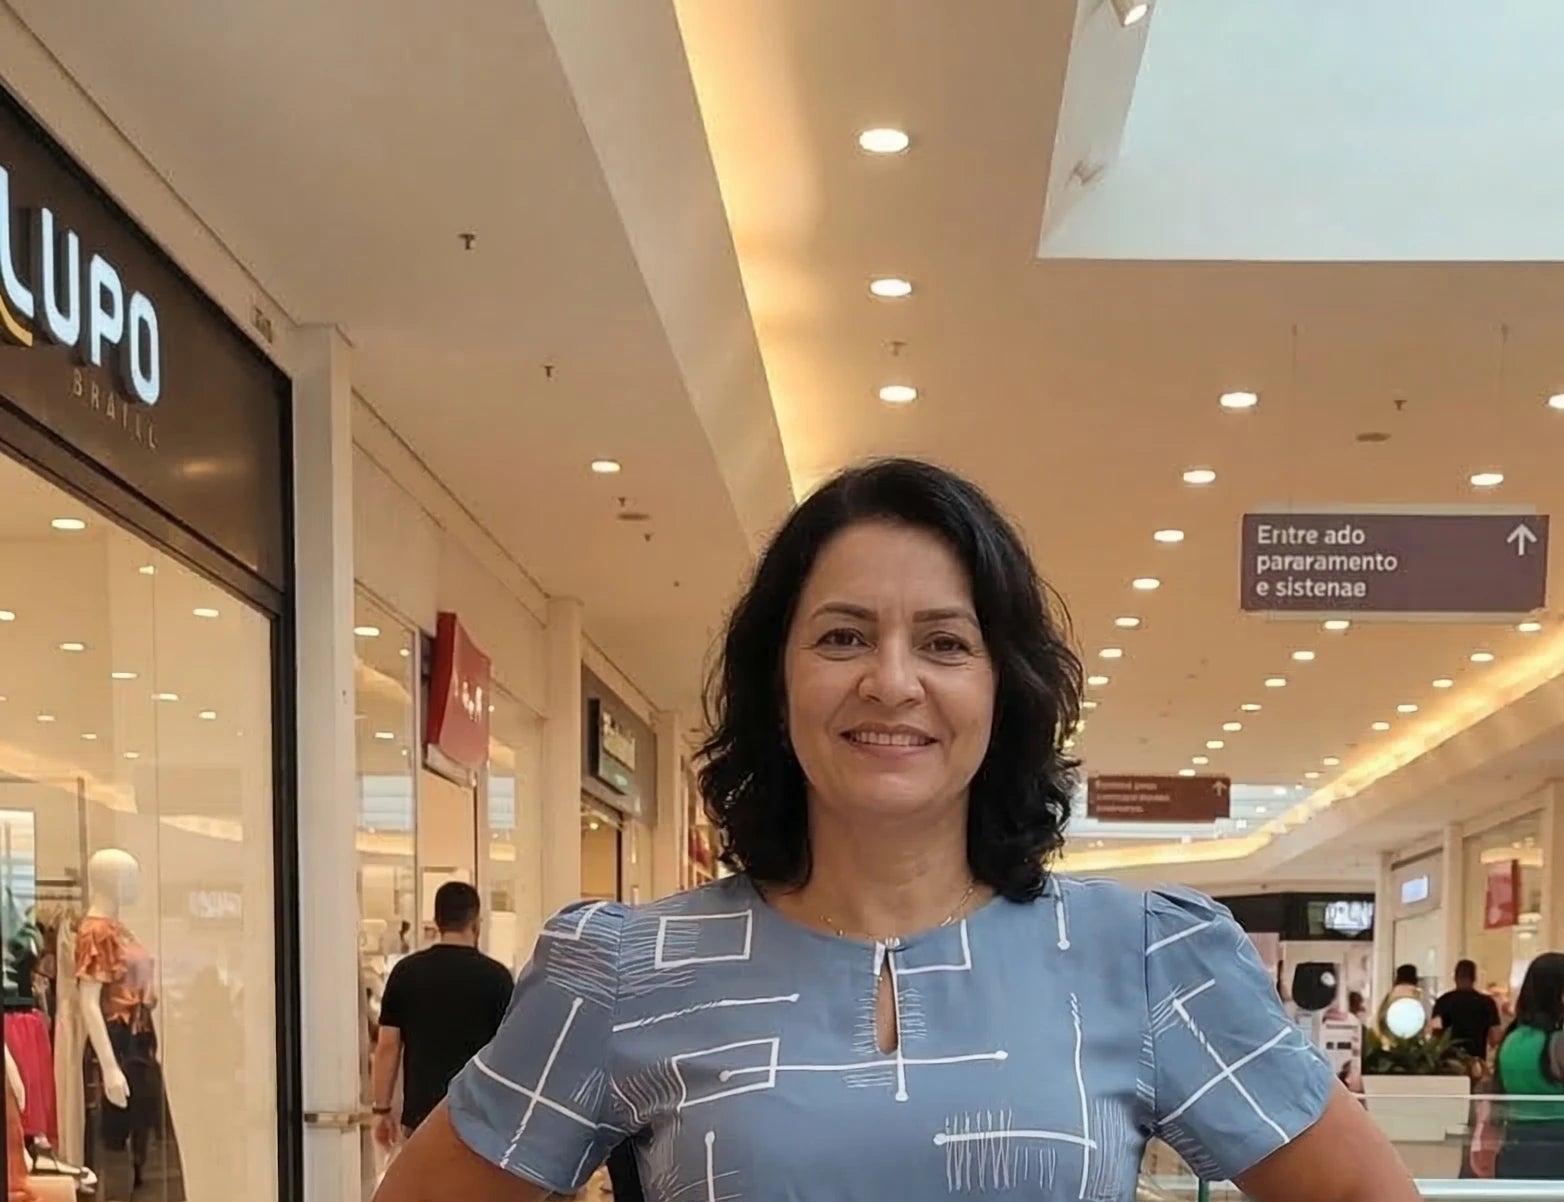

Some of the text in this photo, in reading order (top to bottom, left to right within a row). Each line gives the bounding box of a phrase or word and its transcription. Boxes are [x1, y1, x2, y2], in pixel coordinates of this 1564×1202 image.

[0, 164, 160, 405] LUPO
[1257, 524, 1366, 545] Entre ado
[1256, 553, 1398, 575] pararamento
[1256, 580, 1270, 597] e
